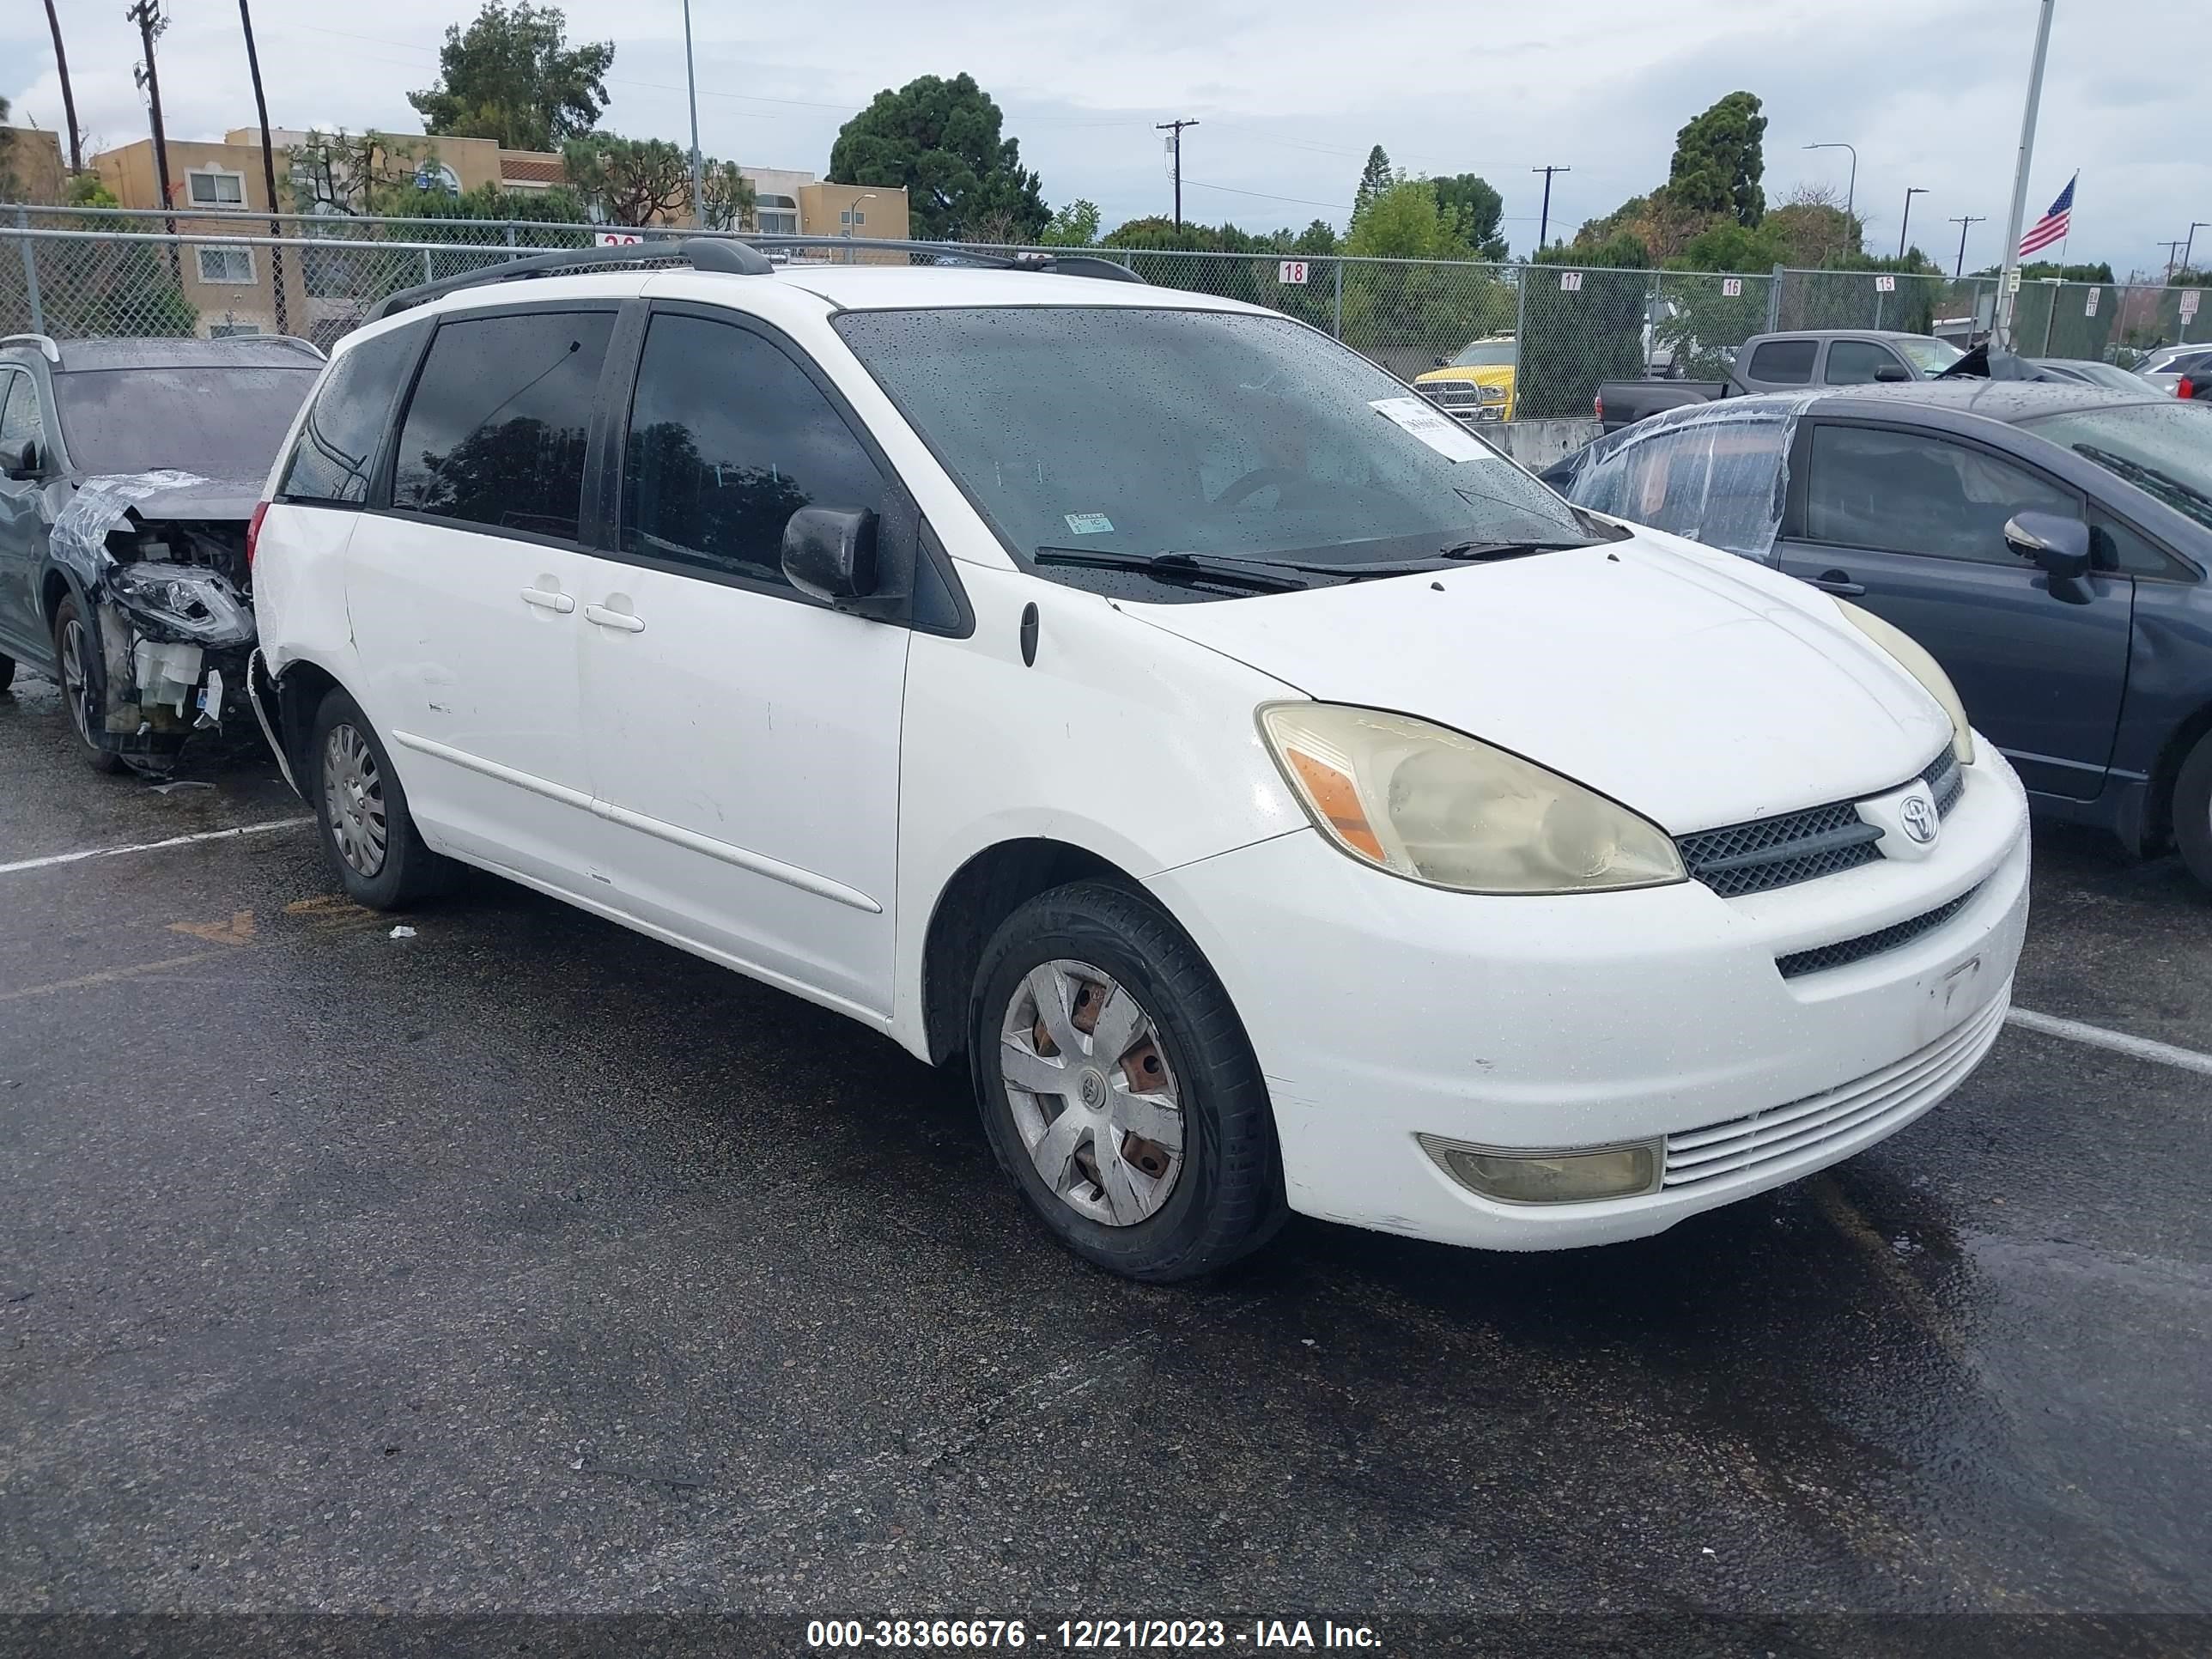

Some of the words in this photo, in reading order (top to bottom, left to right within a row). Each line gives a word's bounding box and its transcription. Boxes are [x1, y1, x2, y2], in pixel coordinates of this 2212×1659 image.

[1285, 263, 1303, 282] 18
[1565, 274, 1579, 289] 17
[1727, 280, 1738, 295] 16
[1879, 276, 1892, 290] 15
